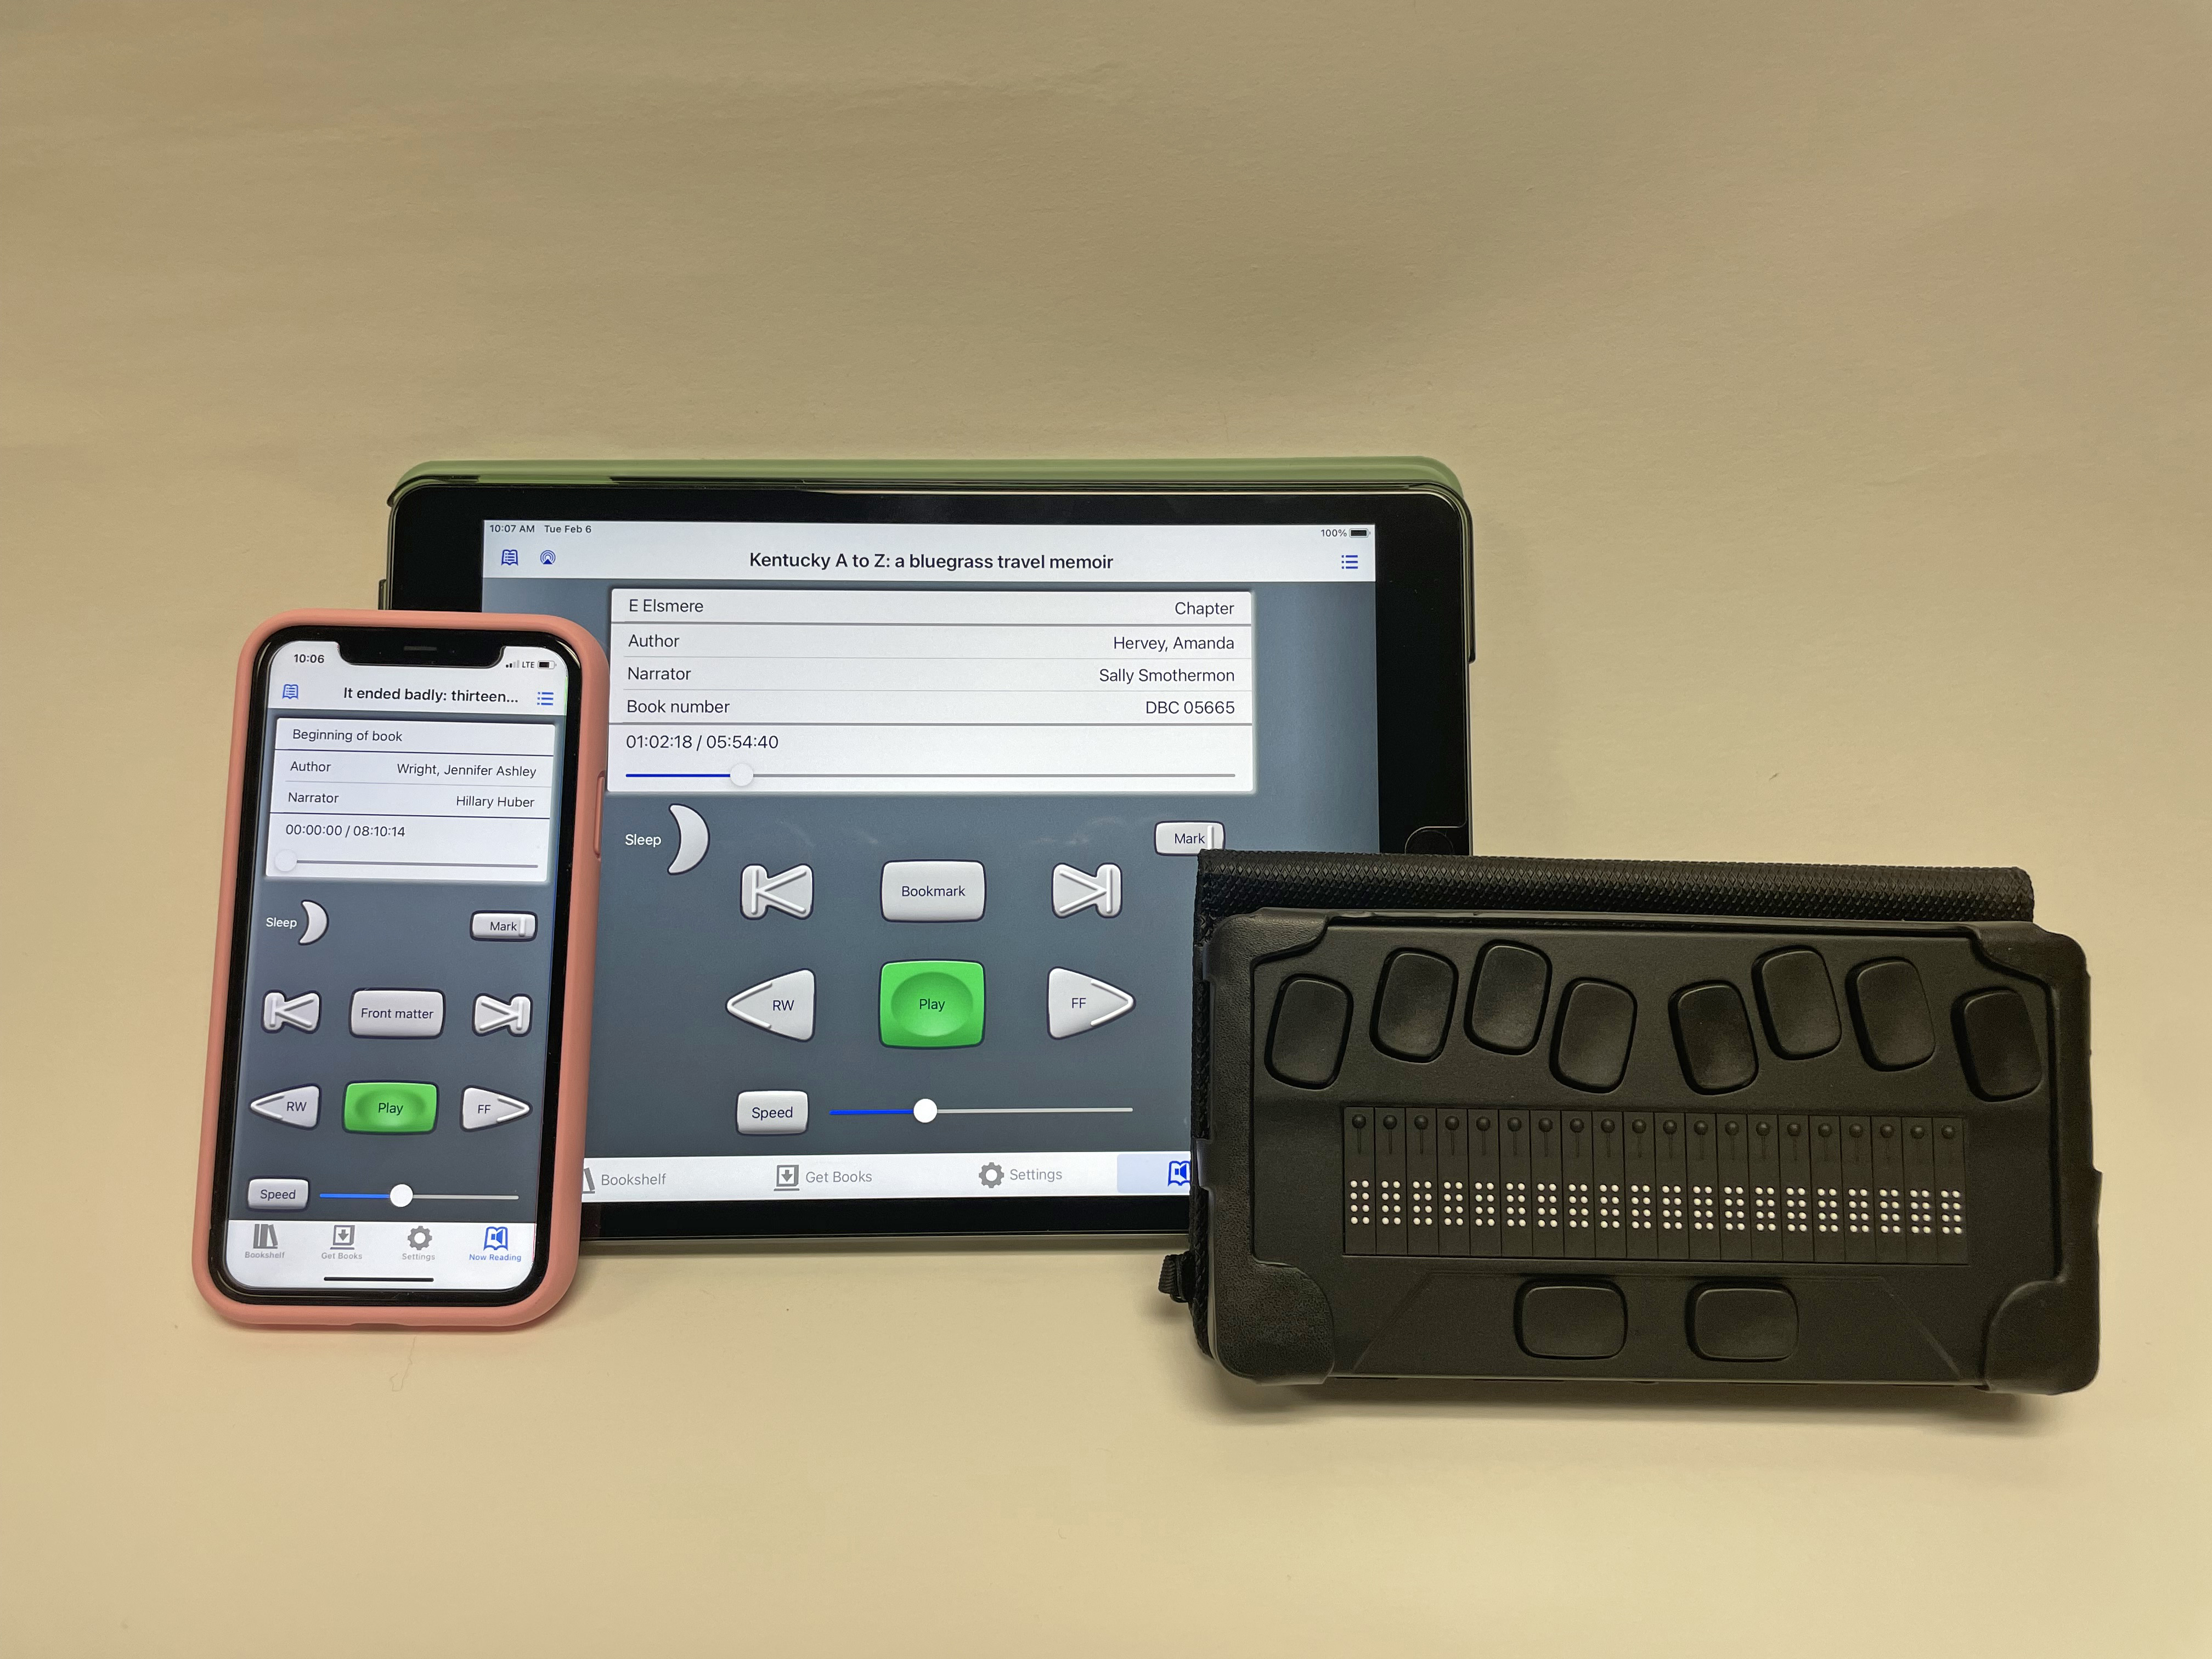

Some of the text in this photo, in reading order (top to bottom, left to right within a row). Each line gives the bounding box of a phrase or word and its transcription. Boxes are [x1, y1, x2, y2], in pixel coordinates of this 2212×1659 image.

[489, 524, 535, 533] 10:07 AM
[544, 525, 591, 533] Tue Feb 6
[1321, 529, 1347, 537] 100%
[750, 552, 1114, 572] Kentucky A to Z: a bluegrass travel memoir
[629, 599, 704, 613] E Elsmere
[1175, 601, 1235, 618] Chapter
[628, 634, 680, 647] Author
[1114, 636, 1234, 652] Hervey, Amanda
[294, 654, 325, 663] 10:06
[628, 667, 692, 680] Narrator
[1099, 668, 1234, 685] Sally Smothermon
[343, 687, 353, 698] It
[357, 687, 400, 699] ended
[404, 688, 447, 703] badly:
[627, 699, 730, 713] Book number
[1146, 701, 1235, 714] DBC 05665
[293, 729, 403, 743] Beginning of book
[626, 735, 778, 752] 01:02:18 / 05:54:40
[290, 761, 332, 772] Author
[397, 763, 537, 779] Wright, Jennifer Ashley
[288, 792, 340, 803] Narrator
[456, 795, 535, 809] Hillary Huber
[286, 824, 405, 838] 00:00:00 / 08:10:14
[625, 833, 662, 848] Sleep
[1175, 832, 1205, 844] Mark
[902, 885, 966, 897] Bookmark
[266, 917, 297, 929] Sleep
[490, 921, 517, 931] Mark
[772, 1000, 794, 1011] RW
[919, 998, 946, 1012] Play
[1071, 997, 1086, 1009] FF
[361, 1008, 434, 1019] Front matter
[286, 1101, 307, 1111] RW
[378, 1102, 404, 1116] Play
[477, 1104, 491, 1114] FF
[752, 1106, 793, 1121] Speed
[601, 1173, 667, 1186] Bookshelf
[805, 1170, 872, 1183] Get Books
[1010, 1168, 1063, 1182] Settings
[260, 1189, 296, 1201] Speed
[402, 1253, 436, 1262] Settings
[489, 1254, 522, 1262] Reading
